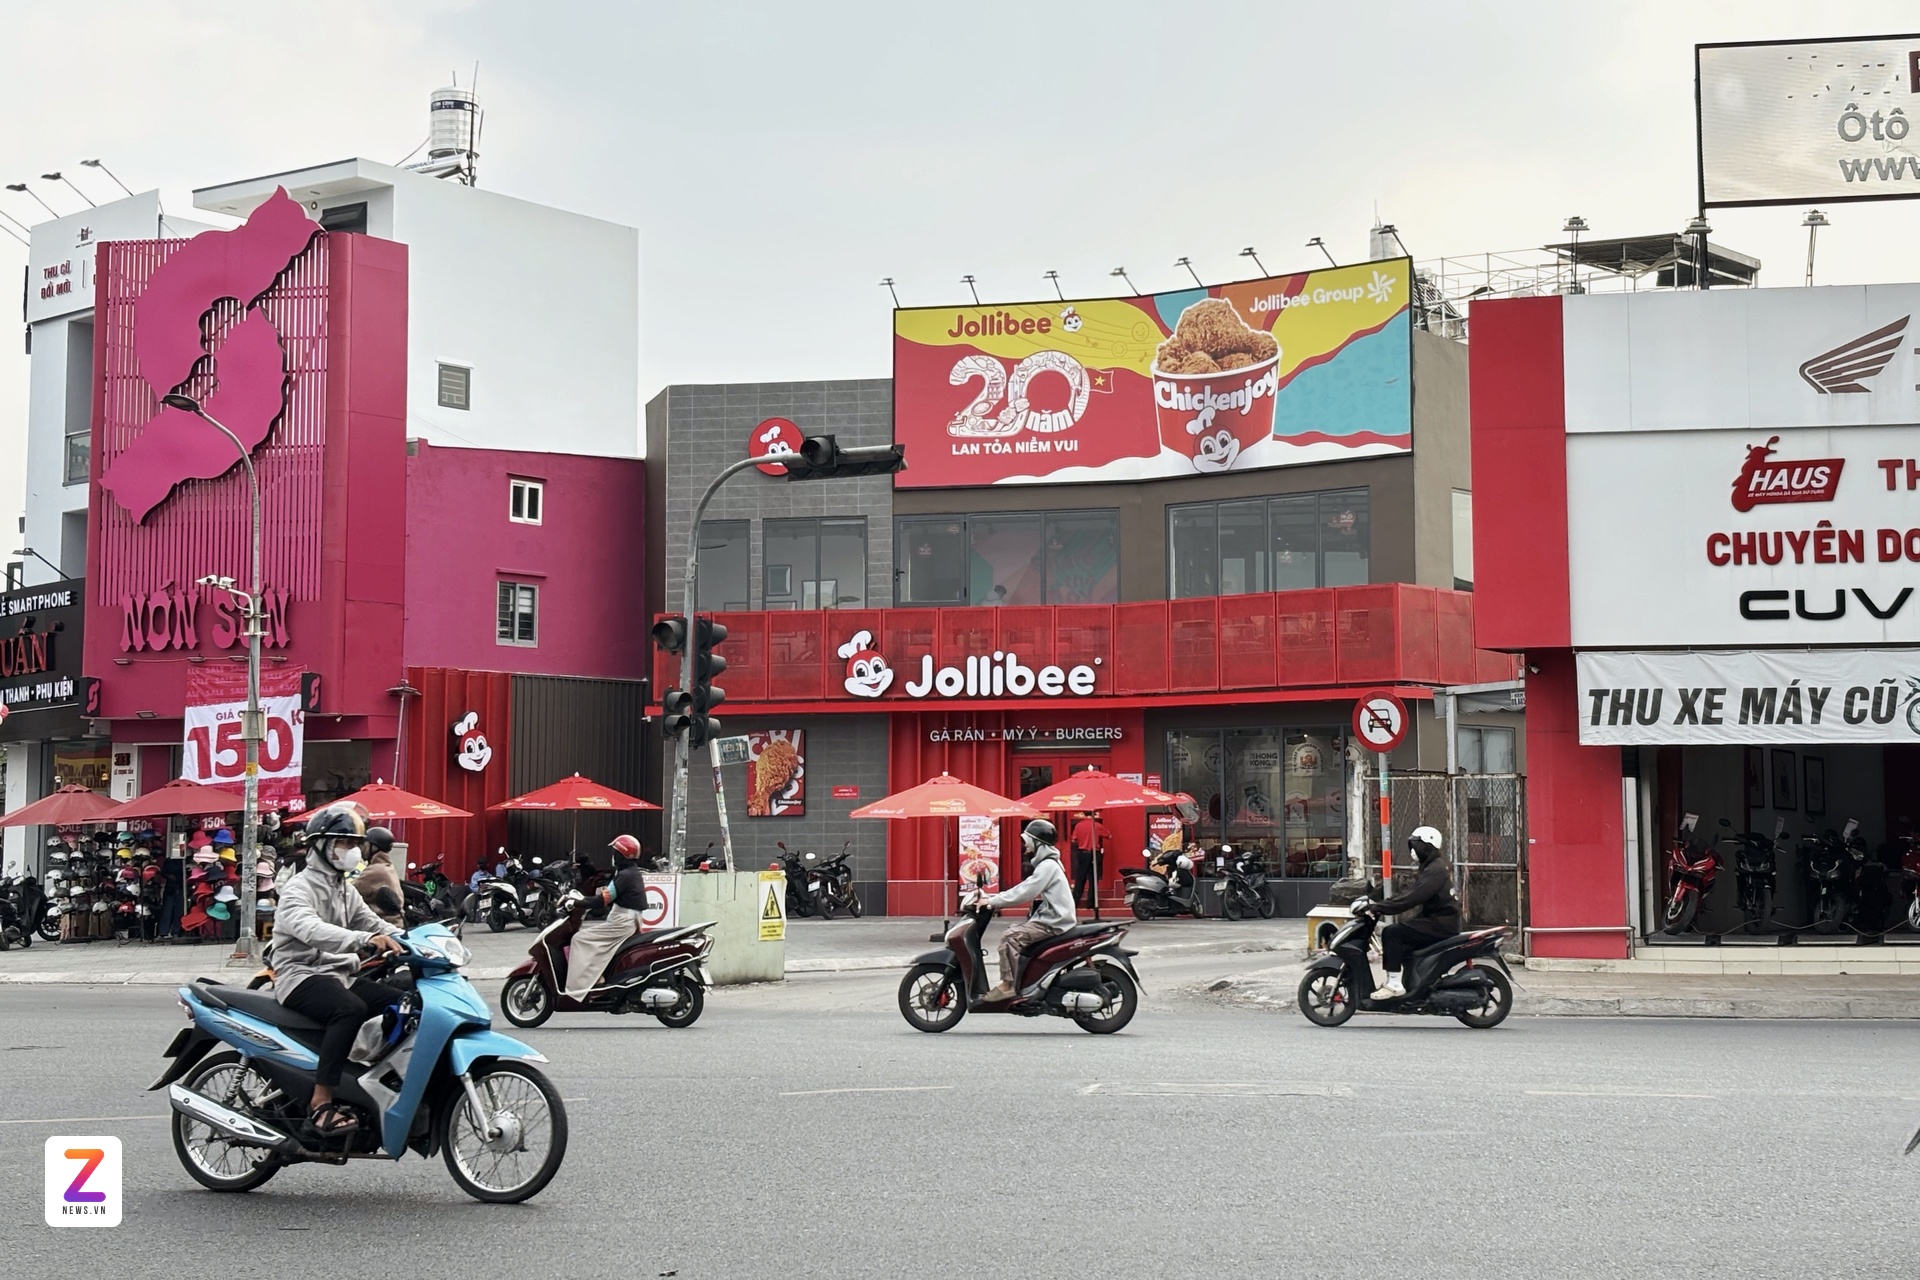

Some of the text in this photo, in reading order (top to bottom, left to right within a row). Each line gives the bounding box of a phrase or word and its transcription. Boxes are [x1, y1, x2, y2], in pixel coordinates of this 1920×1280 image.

[1837, 102, 1910, 142] Ôtô
[43, 265, 59, 280] THU
[1249, 286, 1364, 314] Jollibee Group
[948, 311, 1052, 338] Jollibee
[947, 350, 1091, 437] 20
[1154, 366, 1277, 415] Chickenjoy
[1024, 409, 1075, 433] năm
[952, 442, 980, 455] LAN
[983, 438, 1012, 454] TỎA
[1054, 439, 1078, 452] VUI
[1748, 466, 1831, 492] HAUS
[1706, 520, 1920, 566] CHUYÊN DO
[9, 590, 71, 616] SMARTPHONE
[119, 580, 200, 652] NÓN
[1739, 588, 1914, 620] CUV
[905, 651, 1096, 698] Jollibee
[5, 686, 29, 704] THANH
[36, 682, 53, 703] PHỤ
[54, 676, 73, 701] KIỆN
[1588, 678, 1899, 726] THU XE MÁY CŨ
[216, 708, 234, 721] GIÁ
[930, 725, 1123, 742] GÀ RÁN MỲ Ý BURGERS
[187, 716, 294, 779] 150
[1255, 752, 1278, 760] HONG
[129, 820, 153, 832] 150K
[202, 816, 226, 829] 150K
